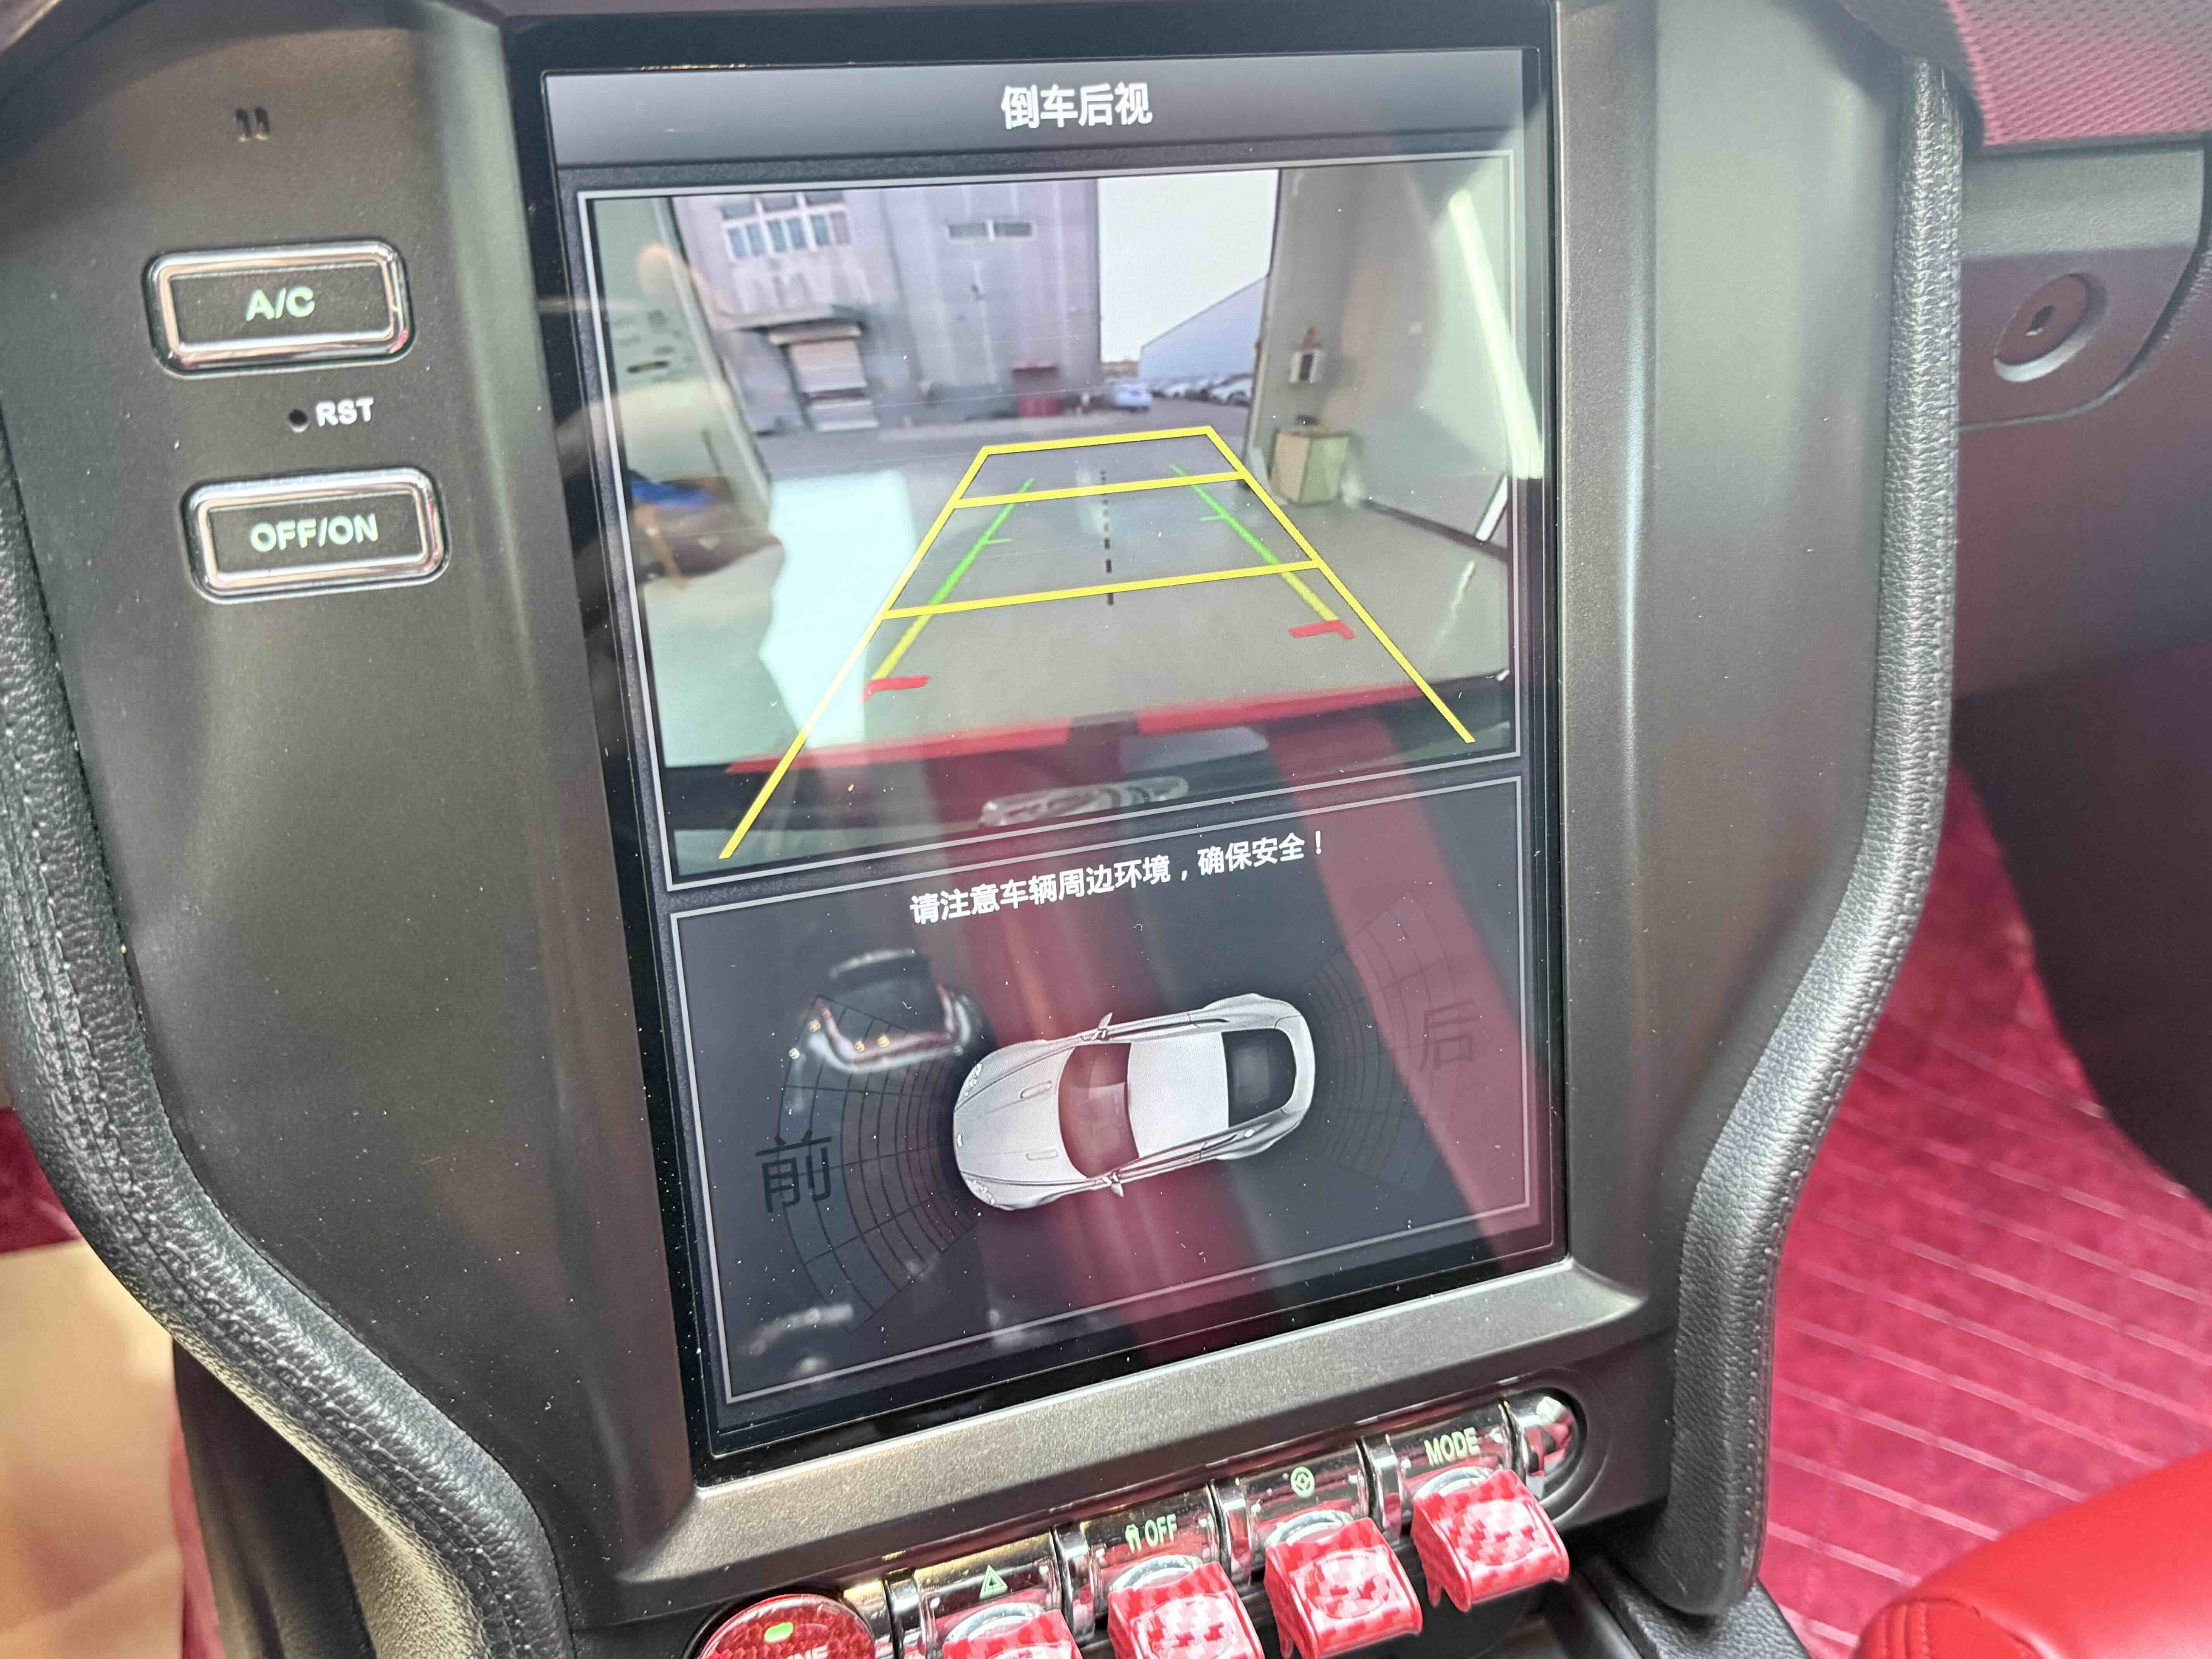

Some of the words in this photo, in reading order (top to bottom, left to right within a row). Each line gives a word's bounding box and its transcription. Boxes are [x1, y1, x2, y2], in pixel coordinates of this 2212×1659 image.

[1001, 81, 1153, 129] 倒车后视
[246, 286, 315, 321] A/C
[316, 396, 374, 426] RST
[250, 513, 378, 552] OFF/ON
[756, 1130, 832, 1213] 前
[1424, 1427, 1480, 1466] MODE
[1144, 1513, 1178, 1547] OFF
